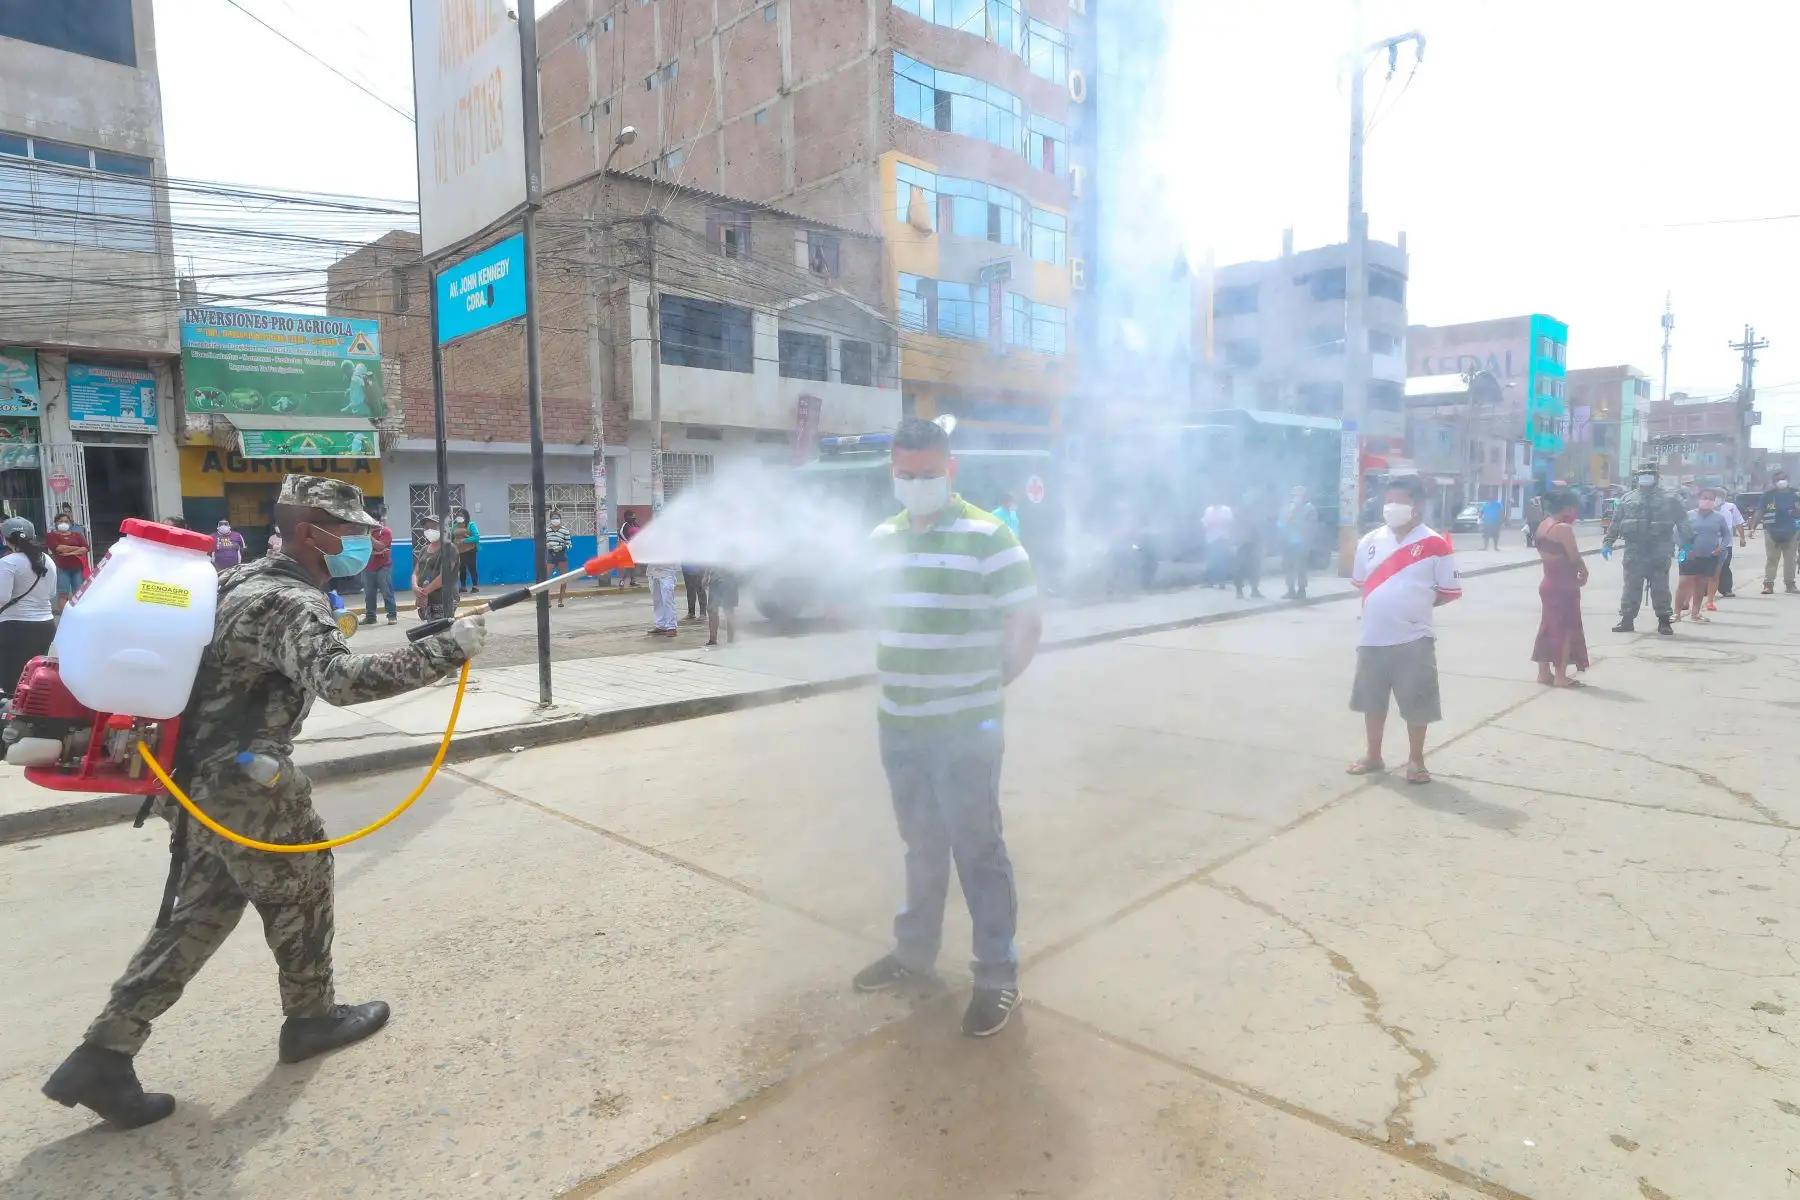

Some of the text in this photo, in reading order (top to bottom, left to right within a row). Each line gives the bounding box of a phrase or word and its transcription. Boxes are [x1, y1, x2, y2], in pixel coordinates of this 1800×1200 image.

[460, 272, 477, 294] JOHN
[478, 257, 510, 286] KENNEDY
[185, 309, 269, 330] INVERSIONES
[271, 316, 294, 332] PRO
[297, 319, 353, 337] AGRICOLA
[202, 450, 372, 474] AGRICOLA
[1368, 544, 1376, 560] 9
[141, 583, 190, 595] TECNOAGRO
